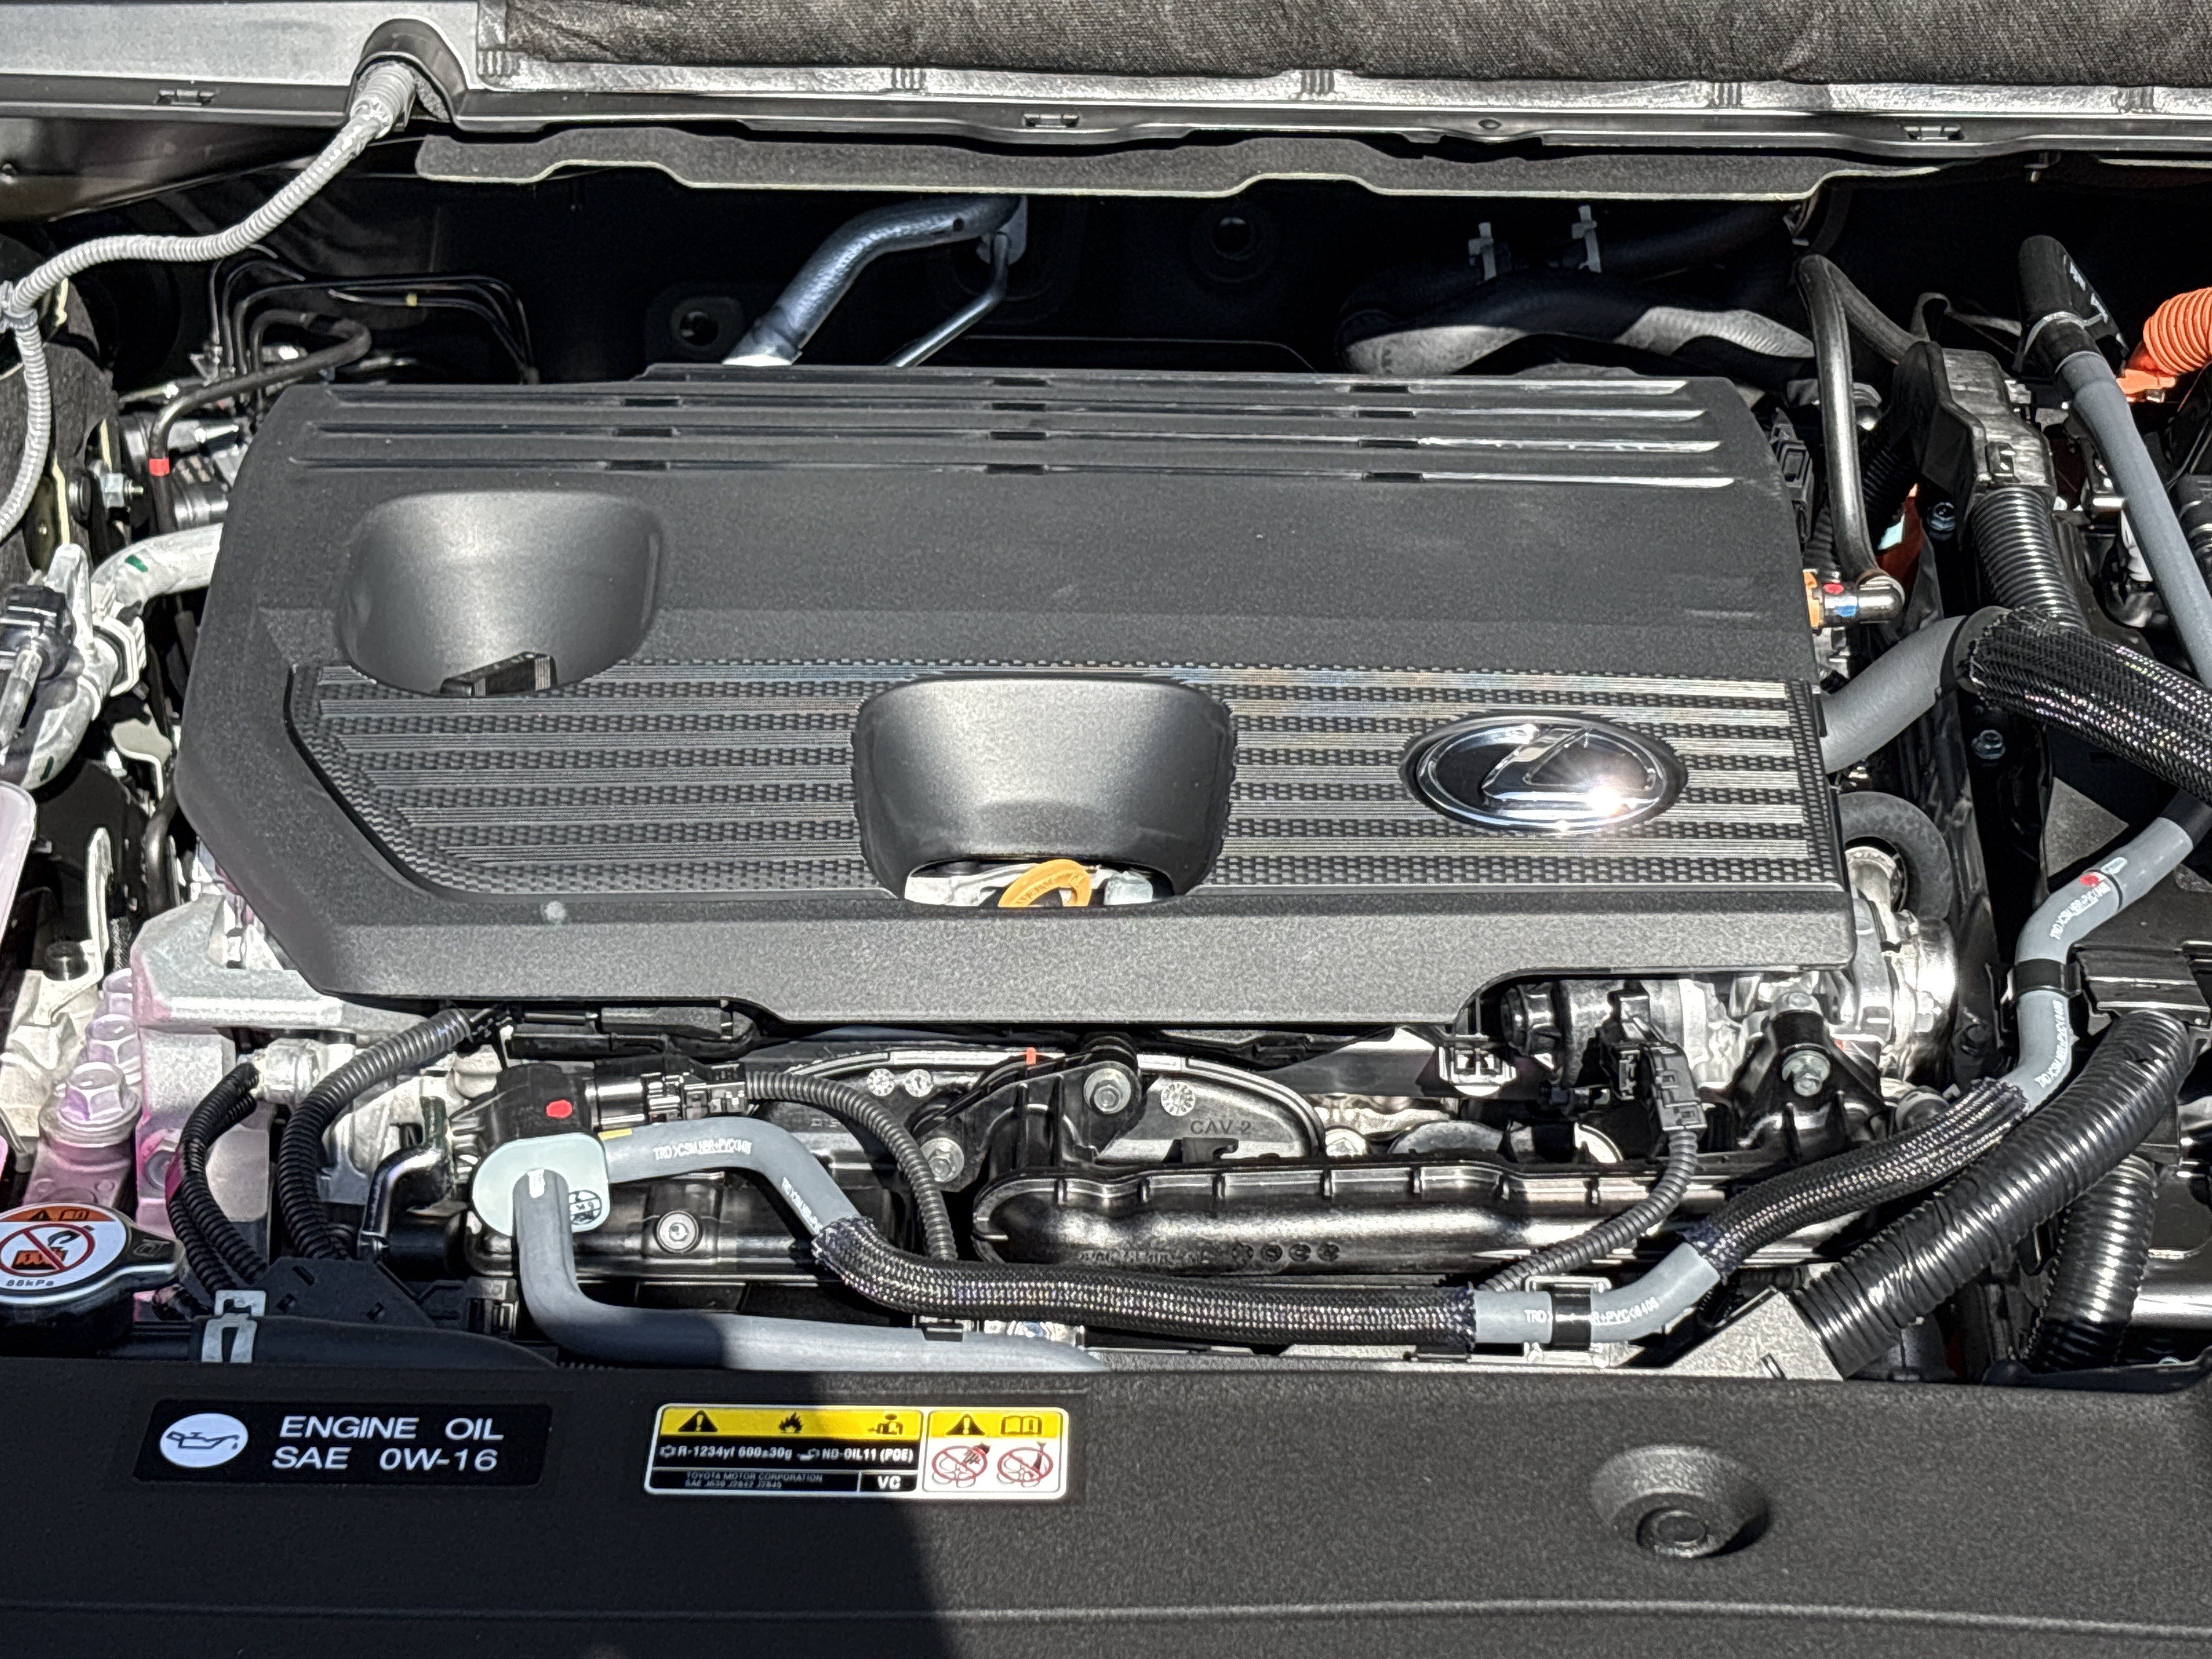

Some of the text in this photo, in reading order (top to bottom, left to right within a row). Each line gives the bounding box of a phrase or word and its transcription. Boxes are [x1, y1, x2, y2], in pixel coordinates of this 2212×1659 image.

[1190, 1119, 1251, 1135] CAV 2
[279, 1415, 505, 1441] ENGINE OIL
[272, 1446, 498, 1471] SAE 0W-16
[677, 1445, 736, 1460] R-1234yf
[687, 1471, 823, 1483] TOYOTA MOTOR CORPORATION
